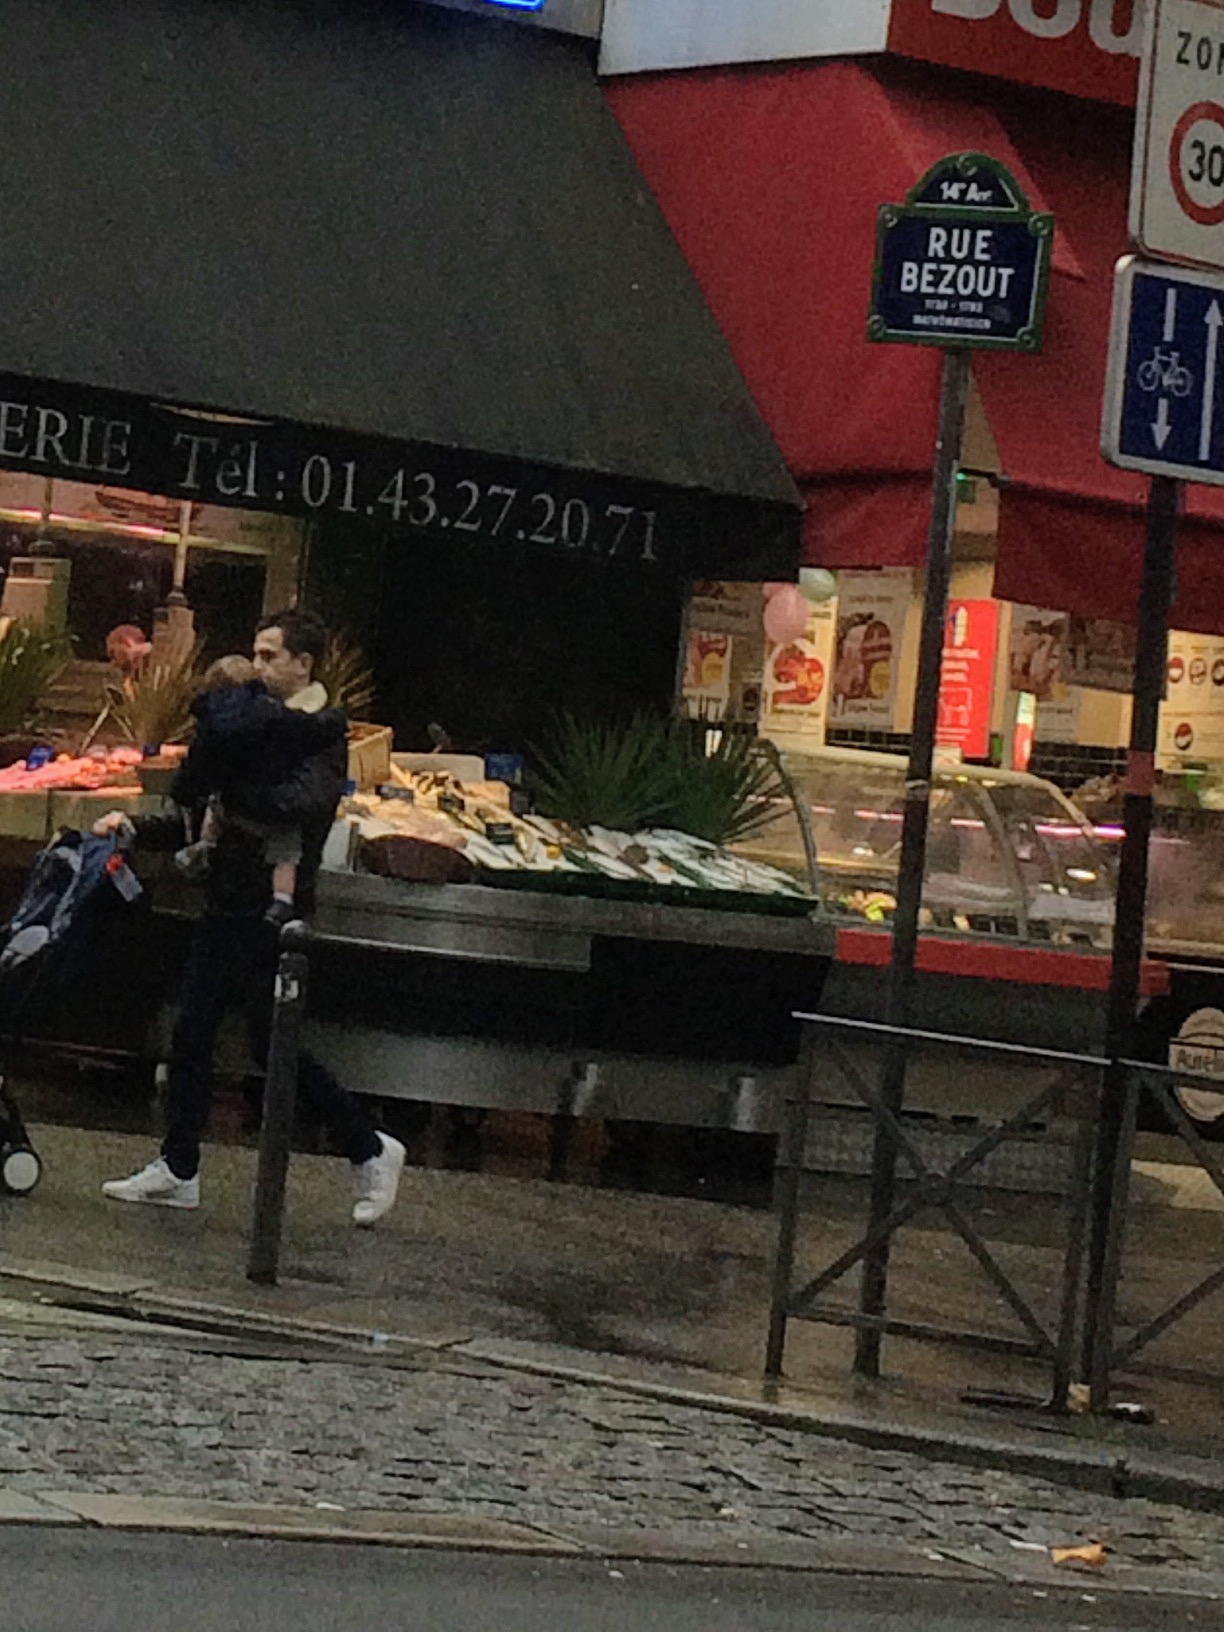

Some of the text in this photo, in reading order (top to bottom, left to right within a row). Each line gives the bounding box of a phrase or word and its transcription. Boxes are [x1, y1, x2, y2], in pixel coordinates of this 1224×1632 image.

[1188, 139, 1224, 187] 30
[927, 226, 994, 261] RUE
[900, 261, 1016, 299] BEZOUT
[301, 454, 658, 561] 01.43.27.20.71
